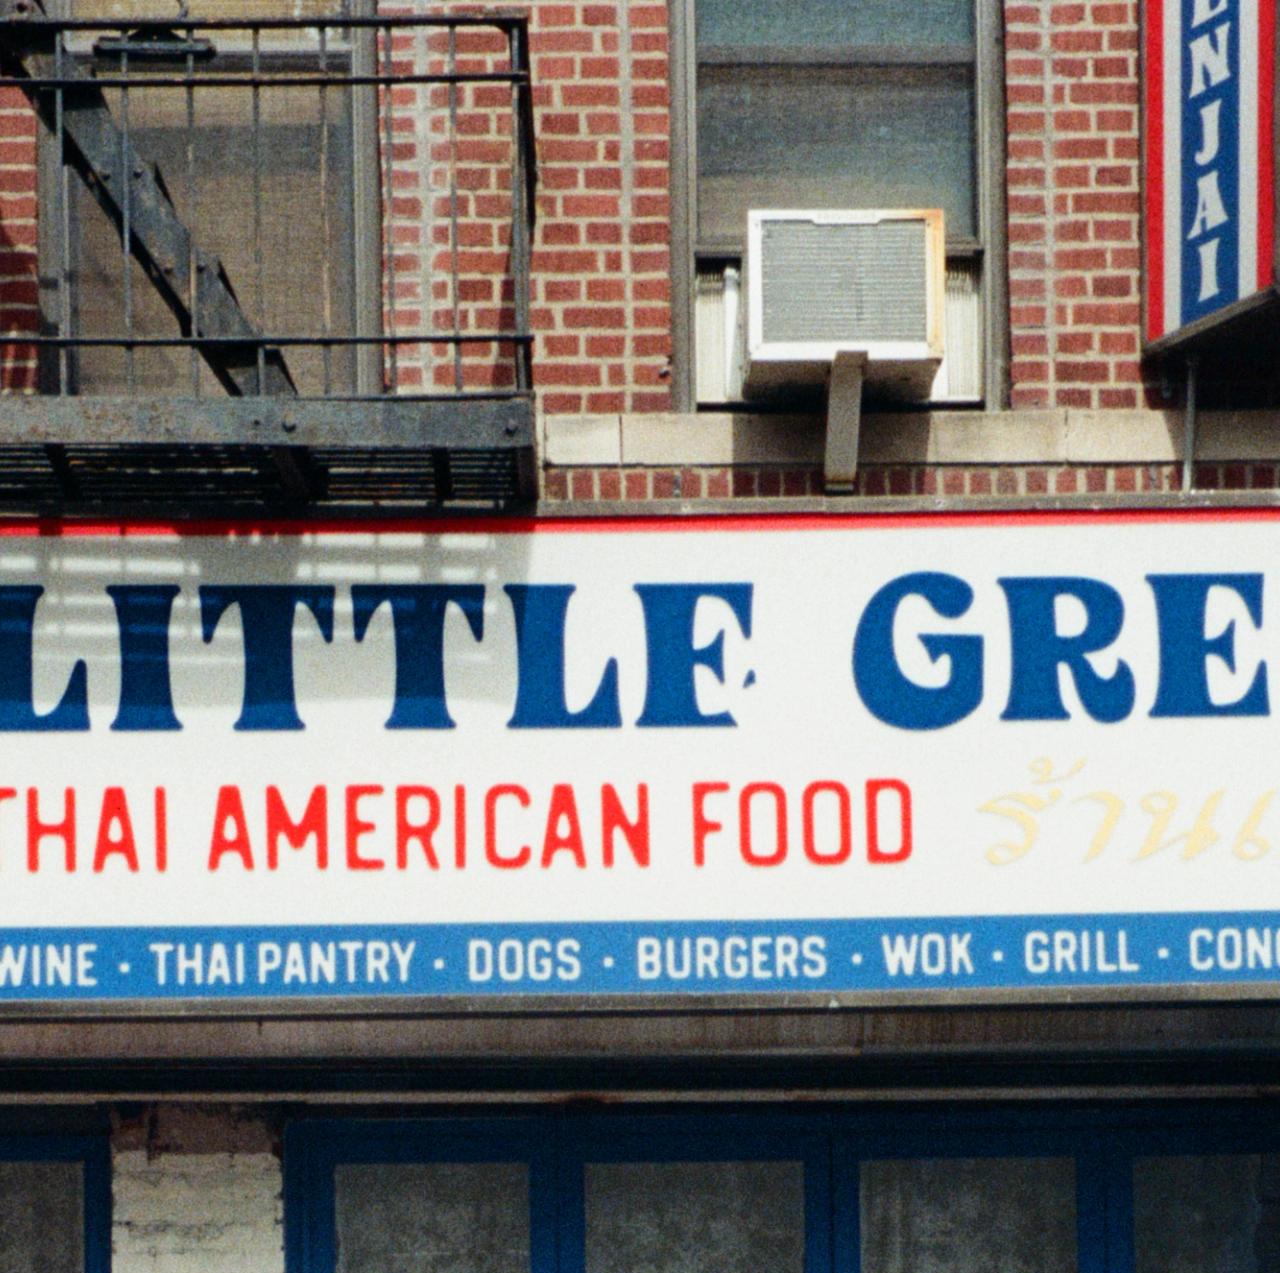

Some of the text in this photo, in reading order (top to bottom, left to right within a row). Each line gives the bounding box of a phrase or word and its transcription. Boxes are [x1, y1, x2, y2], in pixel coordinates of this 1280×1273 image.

[208, 783, 650, 871] AMERICAN
[692, 779, 913, 867] FOOD
[148, 942, 245, 986] THAI
[257, 940, 416, 985] PANTRY
[467, 937, 582, 983] DOGS
[636, 934, 828, 981] BURGERS
[880, 932, 975, 977] WOK
[1023, 929, 1140, 974] GRILL
